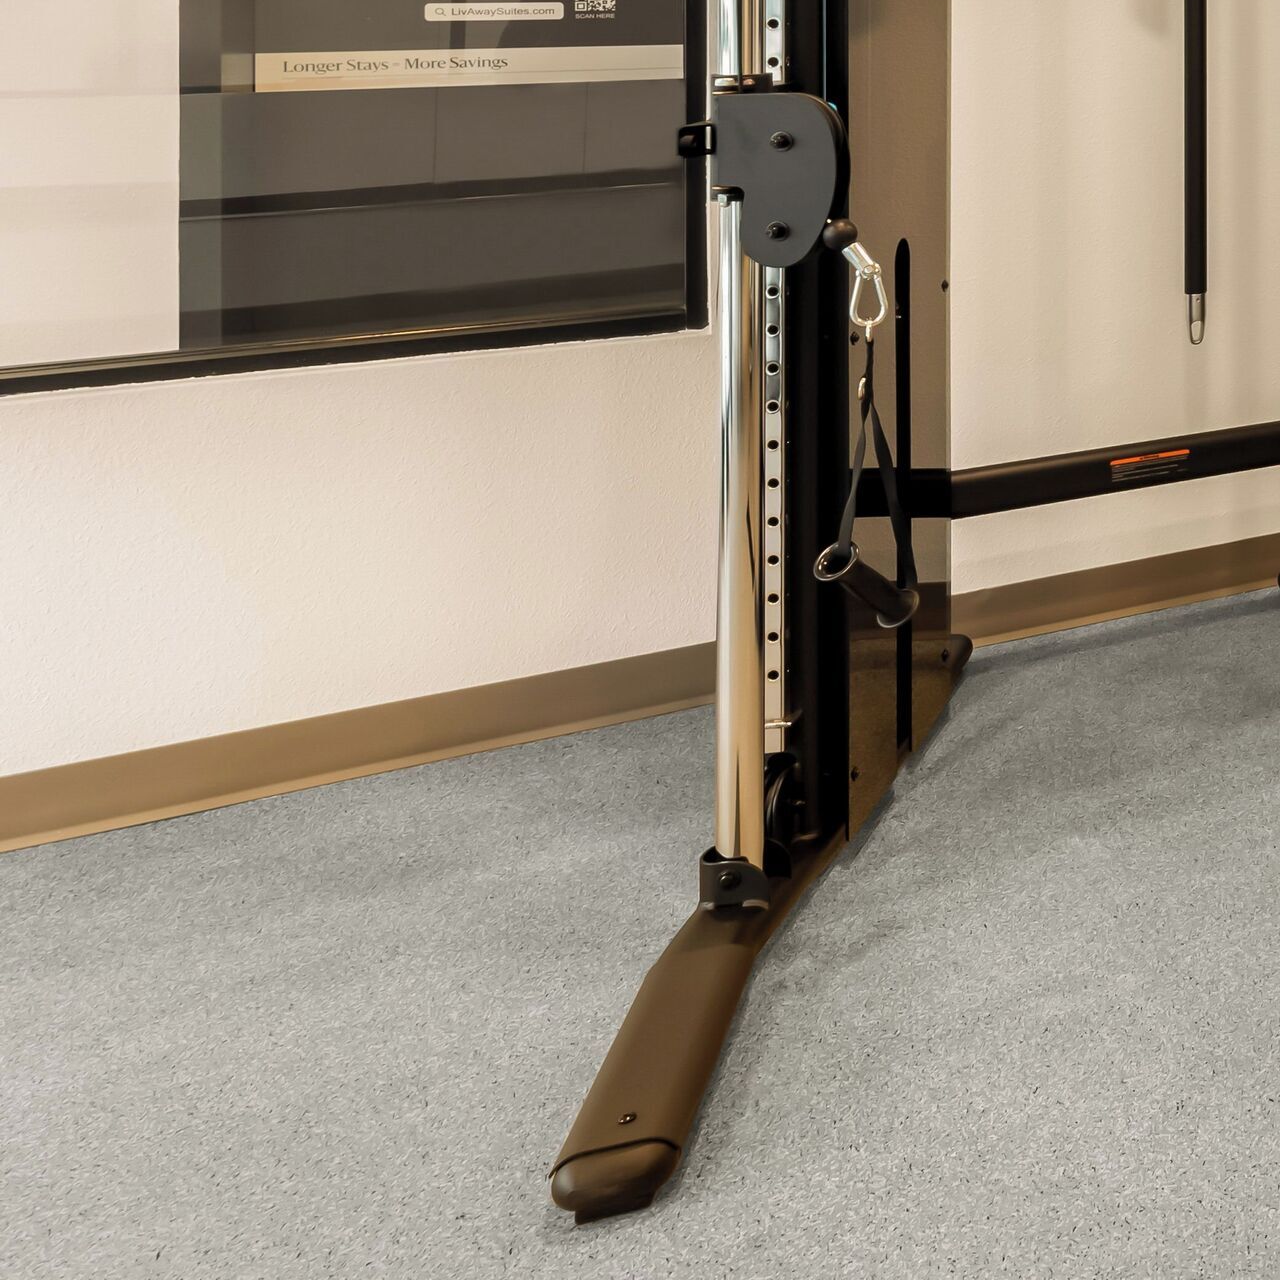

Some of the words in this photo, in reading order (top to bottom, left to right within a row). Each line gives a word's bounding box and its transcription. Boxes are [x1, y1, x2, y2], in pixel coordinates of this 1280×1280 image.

[451, 7, 555, 16] LivAwaySuites.com
[283, 61, 342, 73] Longer
[347, 59, 389, 71] Stays
[405, 58, 446, 69] More
[449, 56, 508, 70] Savings
